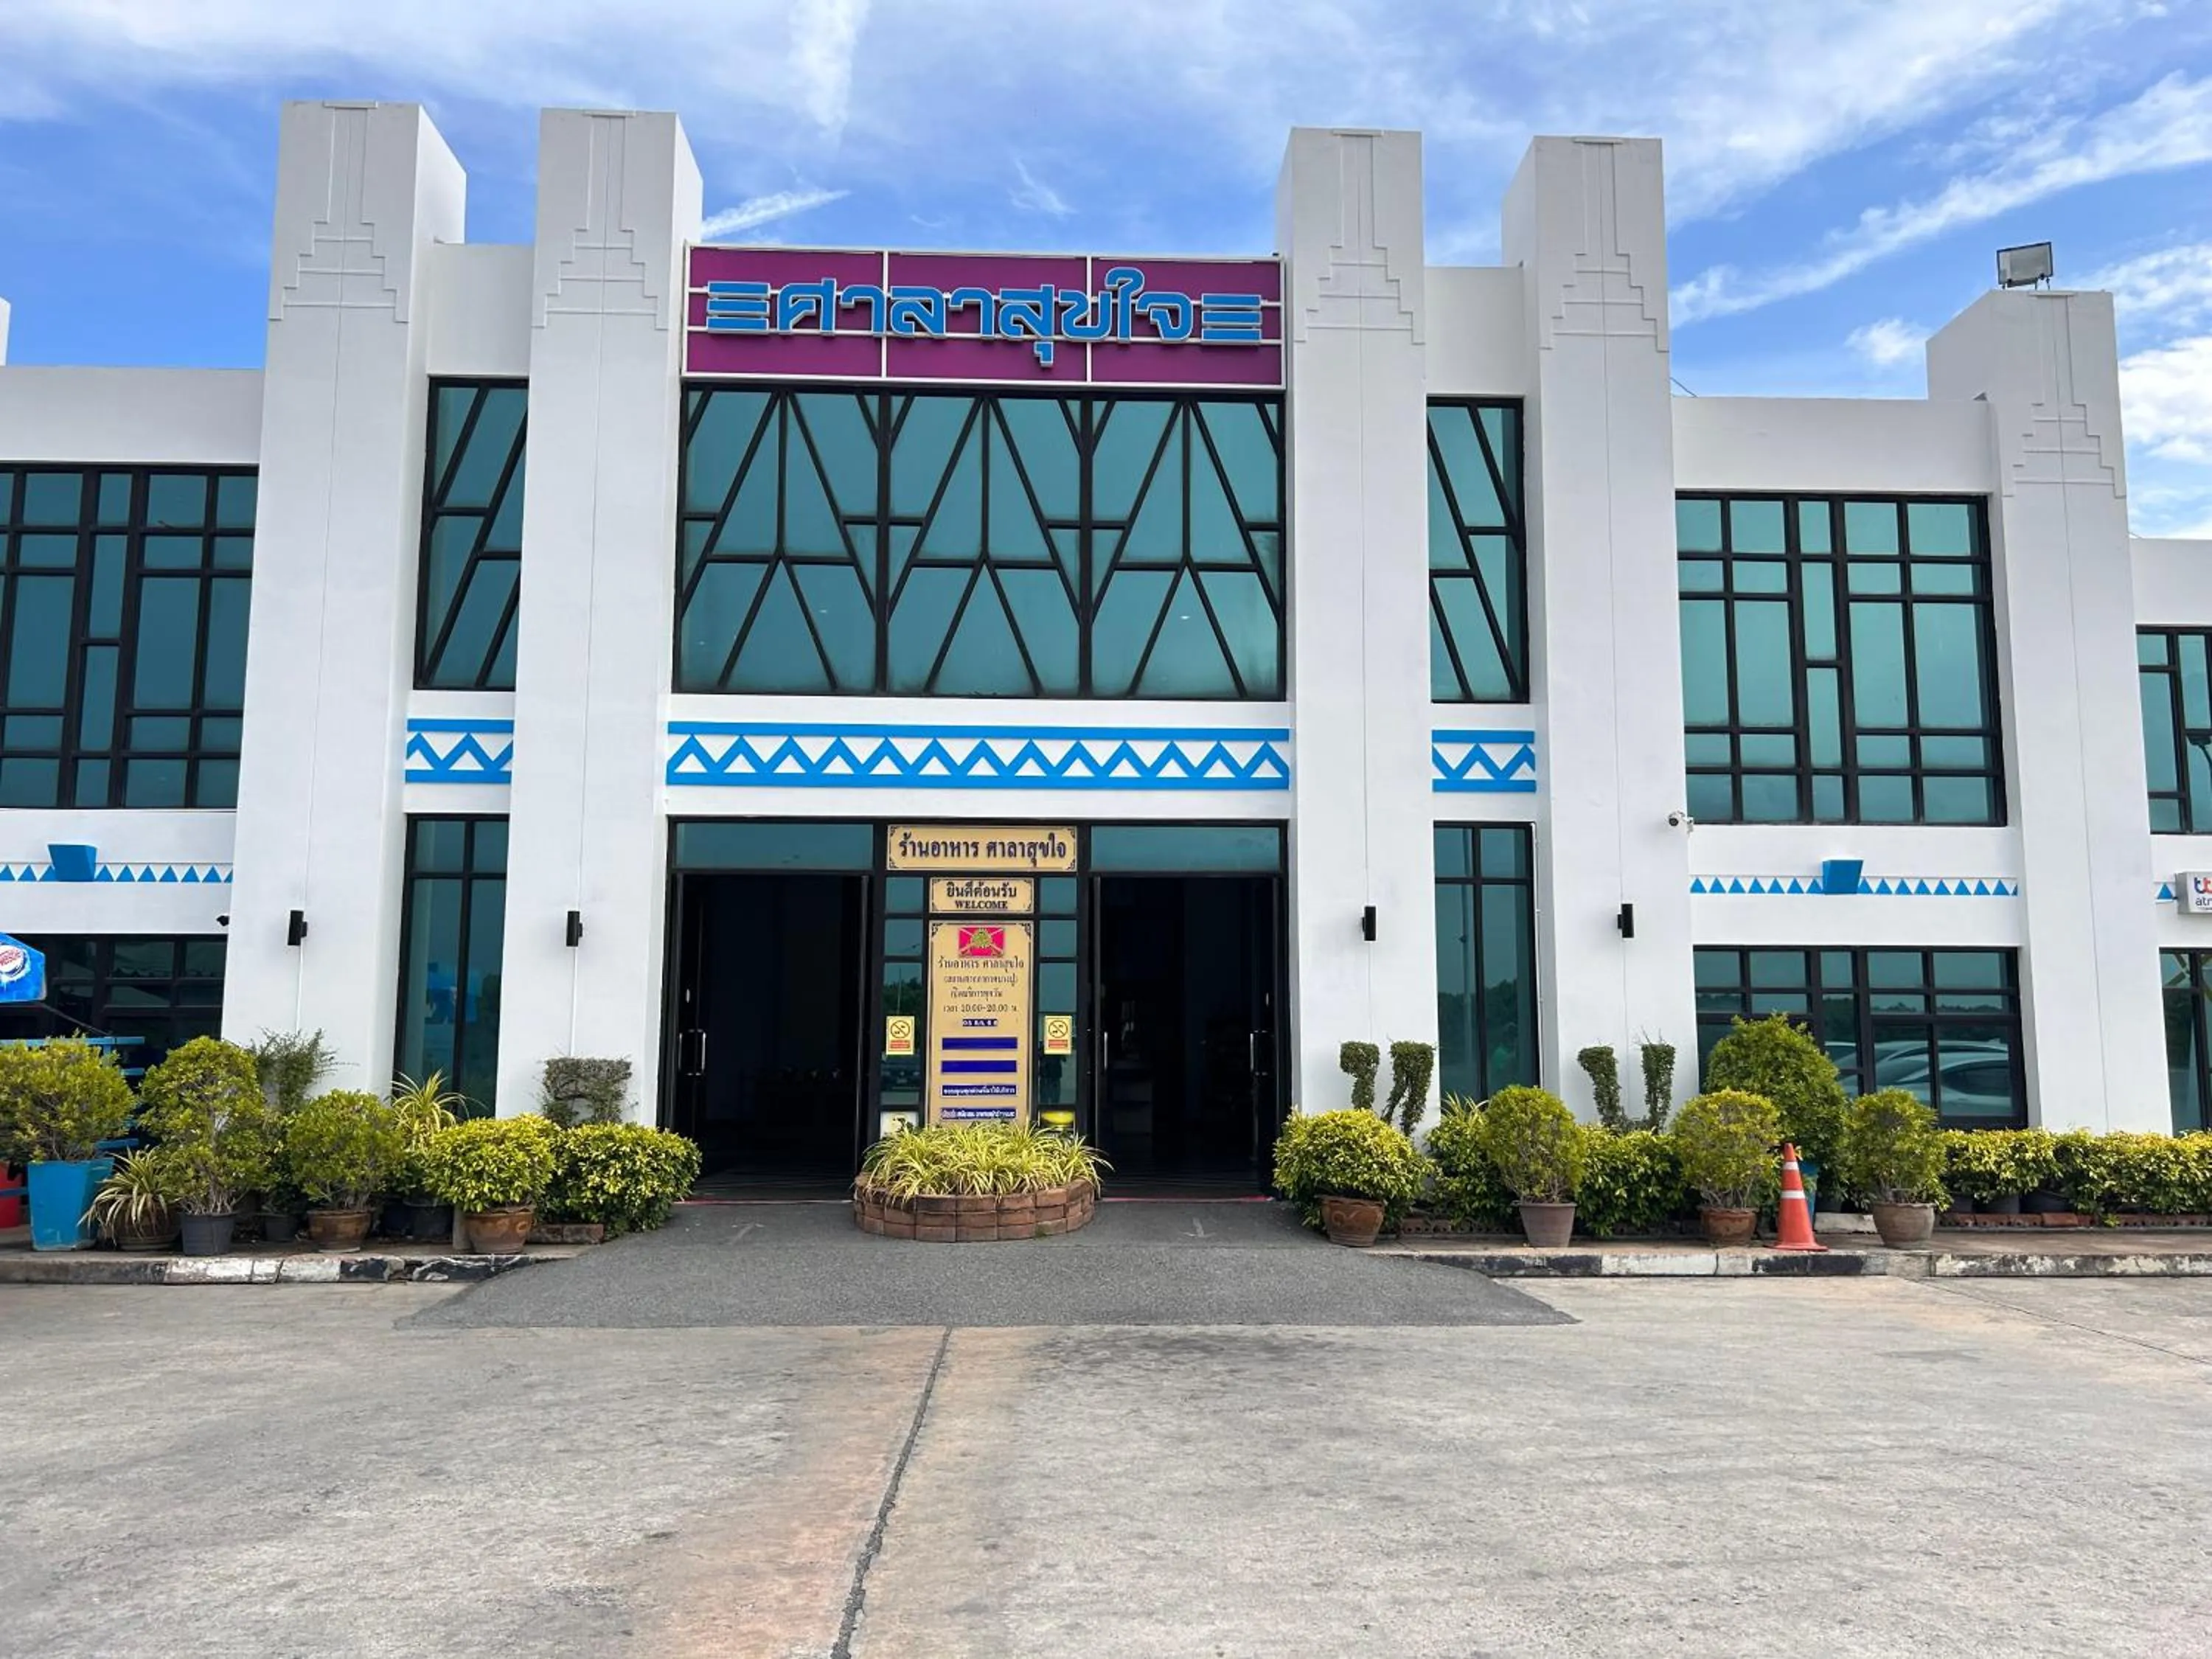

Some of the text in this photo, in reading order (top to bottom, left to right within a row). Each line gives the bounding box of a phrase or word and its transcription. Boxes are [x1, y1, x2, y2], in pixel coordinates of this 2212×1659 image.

[776, 266, 1194, 367] ศาลาสุขใจ
[899, 832, 1067, 867] ร้านอาหาร ศาลาสุขใจ
[946, 881, 1018, 898] ยินดีต้อนรับ
[954, 900, 1009, 909] WELCOME
